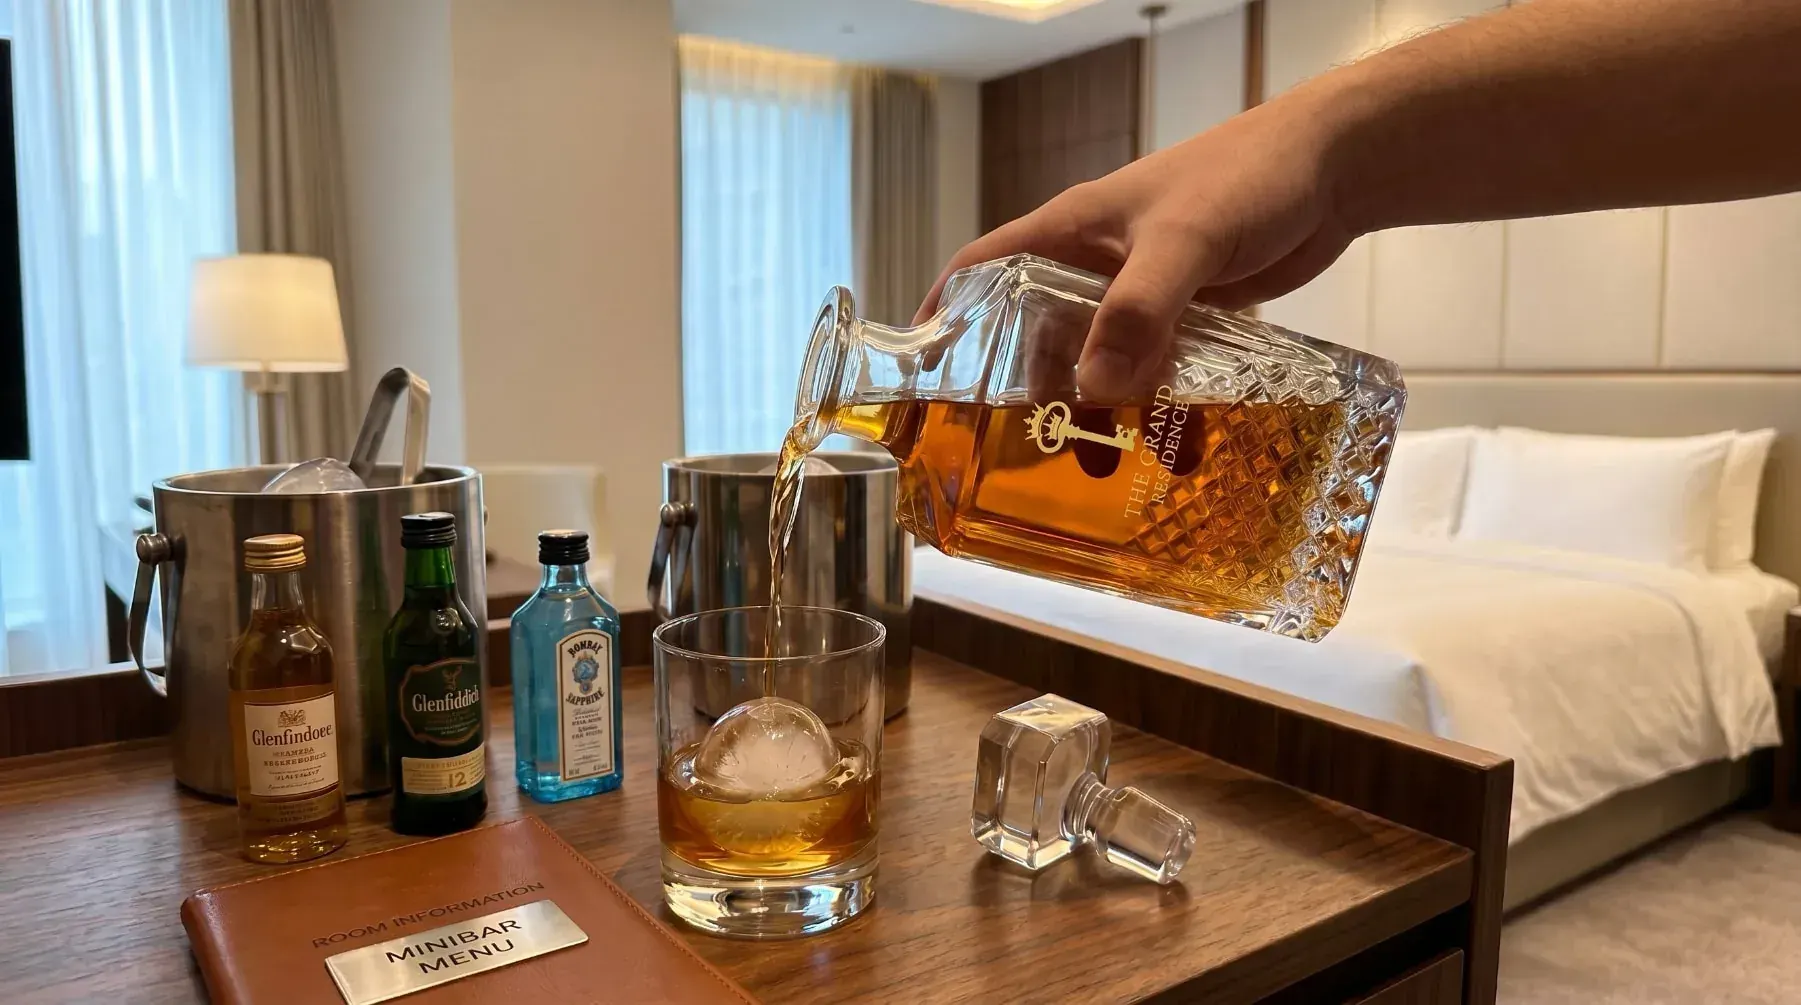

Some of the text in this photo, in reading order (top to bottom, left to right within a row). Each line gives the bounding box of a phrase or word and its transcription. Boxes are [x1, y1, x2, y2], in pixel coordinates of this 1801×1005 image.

[1124, 385, 1173, 518] THE GRAND
[1151, 400, 1190, 504] RESIDENCE
[567, 640, 603, 658] BOMBAY
[412, 685, 479, 712] Glenfiddich
[566, 687, 605, 706] SAPPHIRE
[448, 772, 467, 788] 12
[312, 882, 545, 948] ROOM INFORMATION
[386, 919, 522, 963] MINIBAR
[418, 939, 514, 974] MENU
